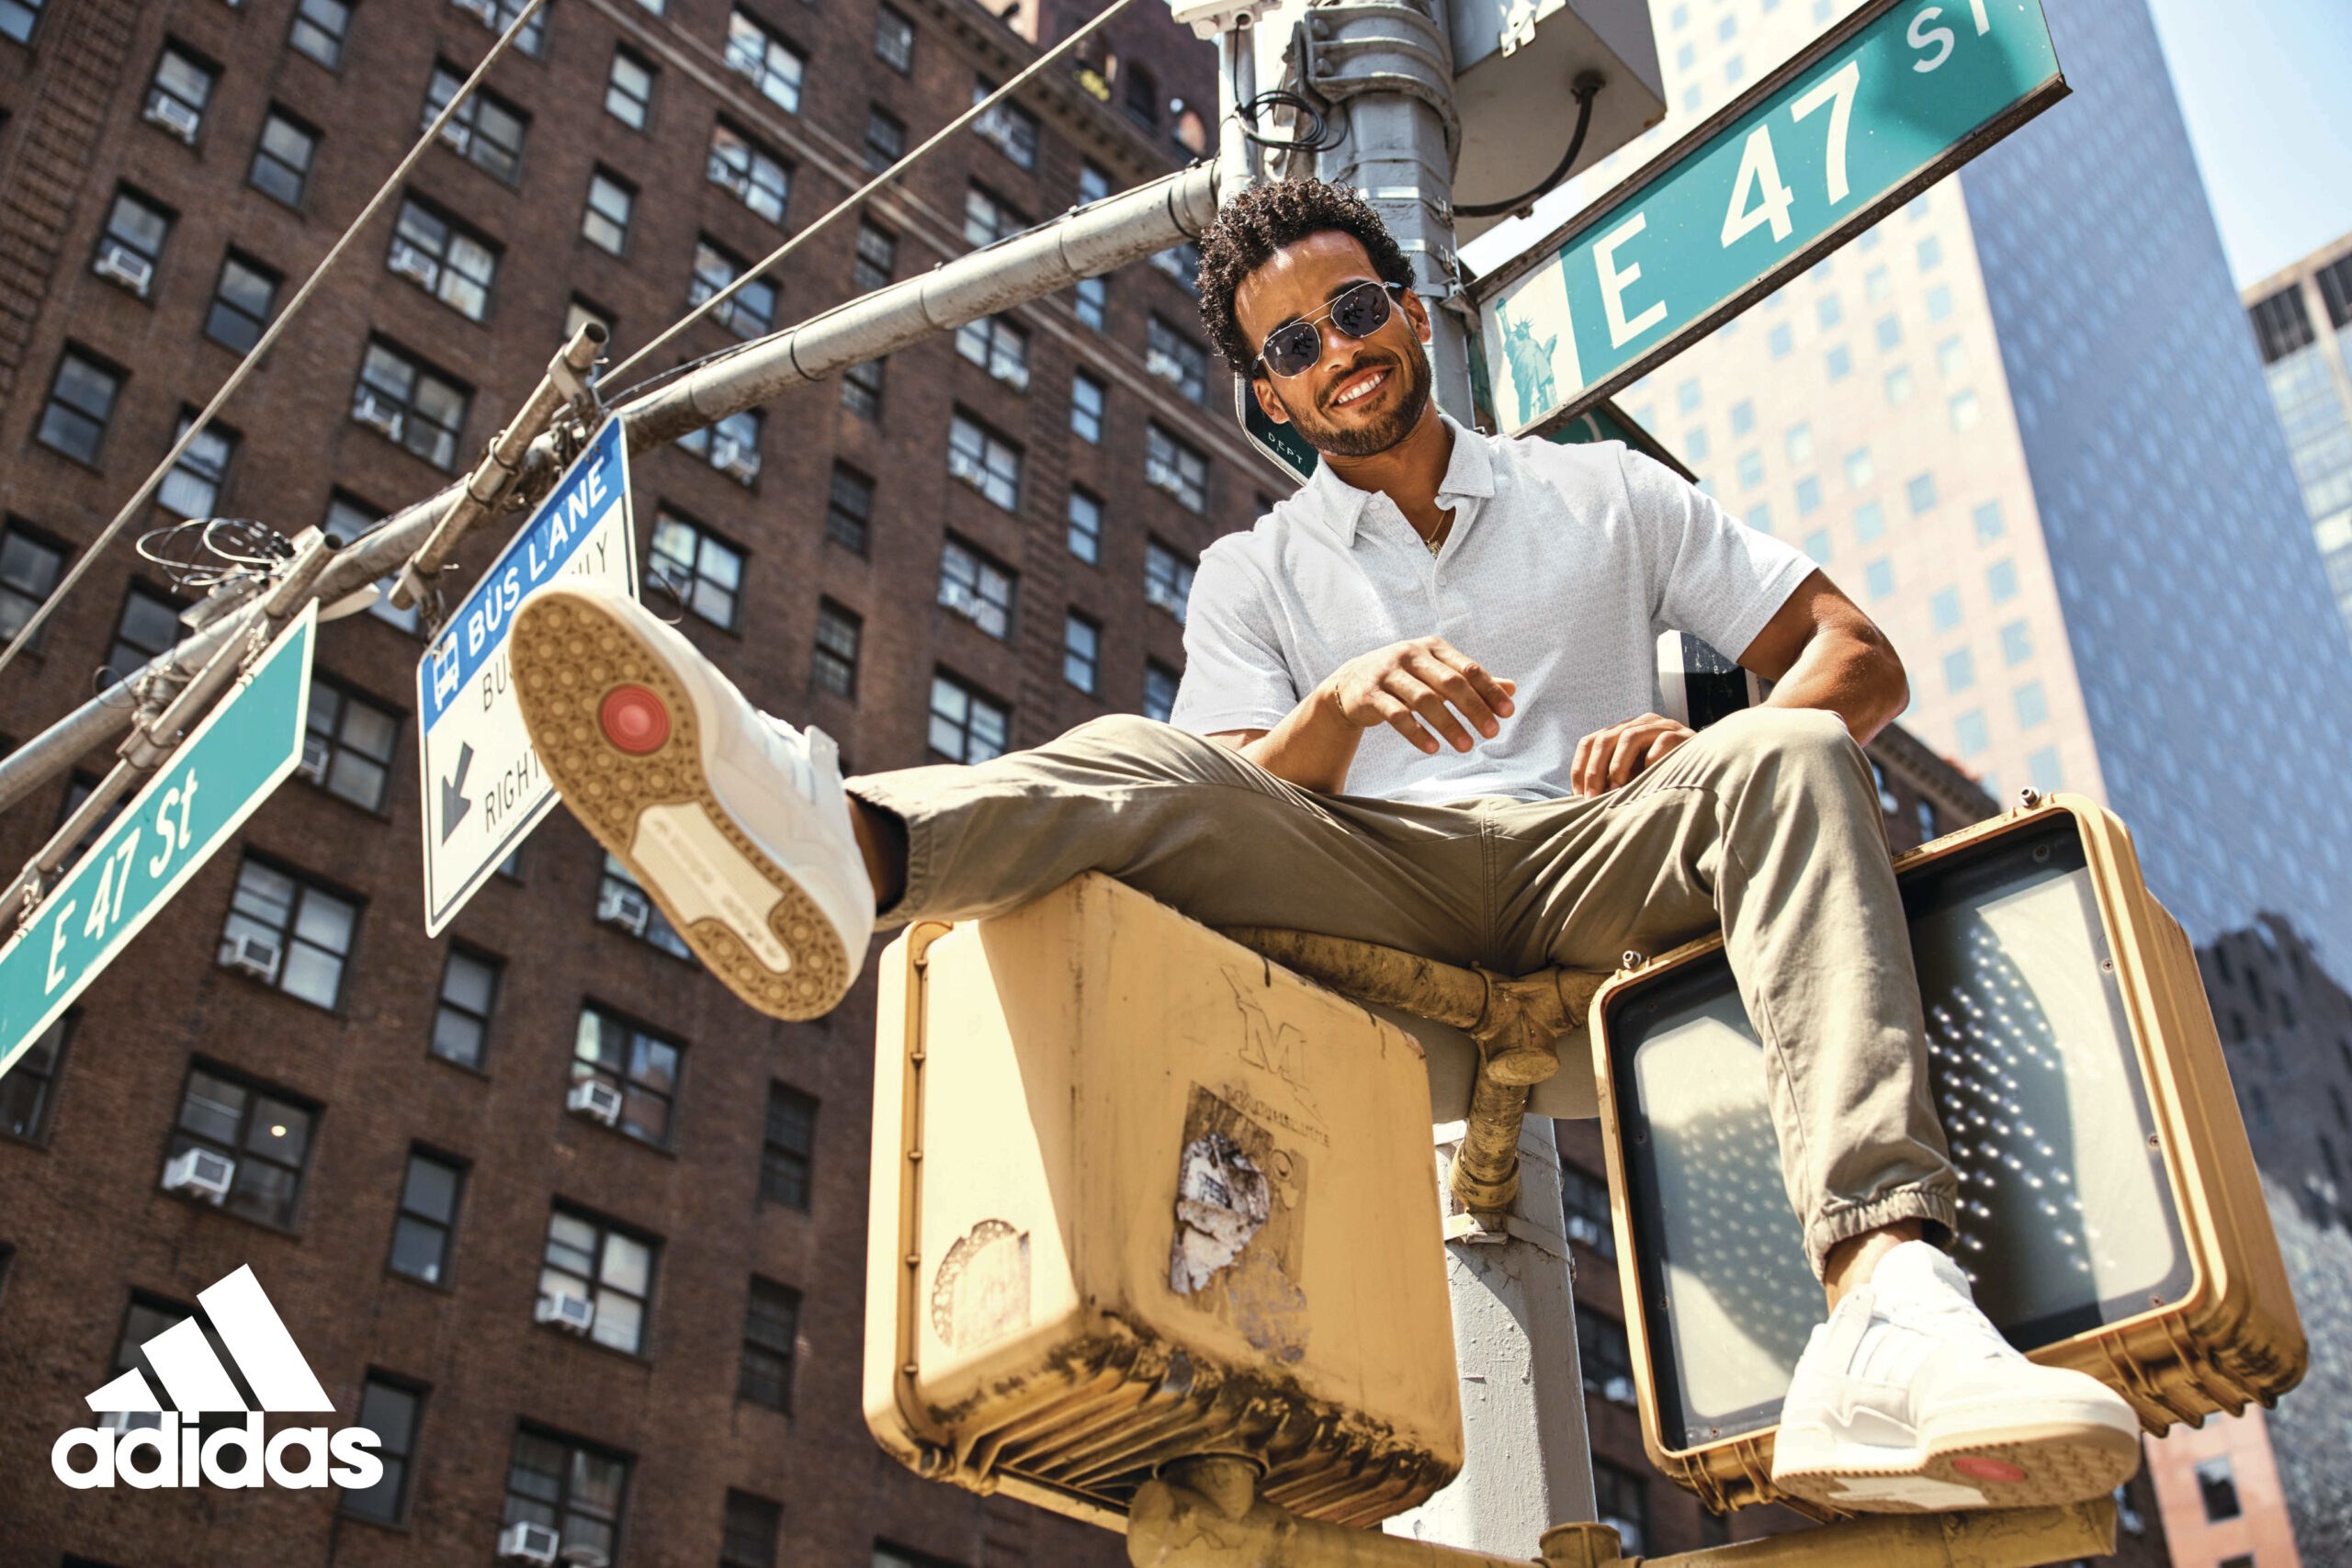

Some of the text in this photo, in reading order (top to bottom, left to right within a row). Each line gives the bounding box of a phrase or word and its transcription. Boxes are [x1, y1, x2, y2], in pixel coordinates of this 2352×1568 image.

[1591, 212, 1668, 350] E
[1721, 60, 1860, 249] 47
[1268, 432, 1304, 464] DEPT
[468, 567, 519, 657] BUS
[529, 457, 607, 581] LANE
[482, 653, 513, 713] BU
[45, 768, 198, 996] E 47 St
